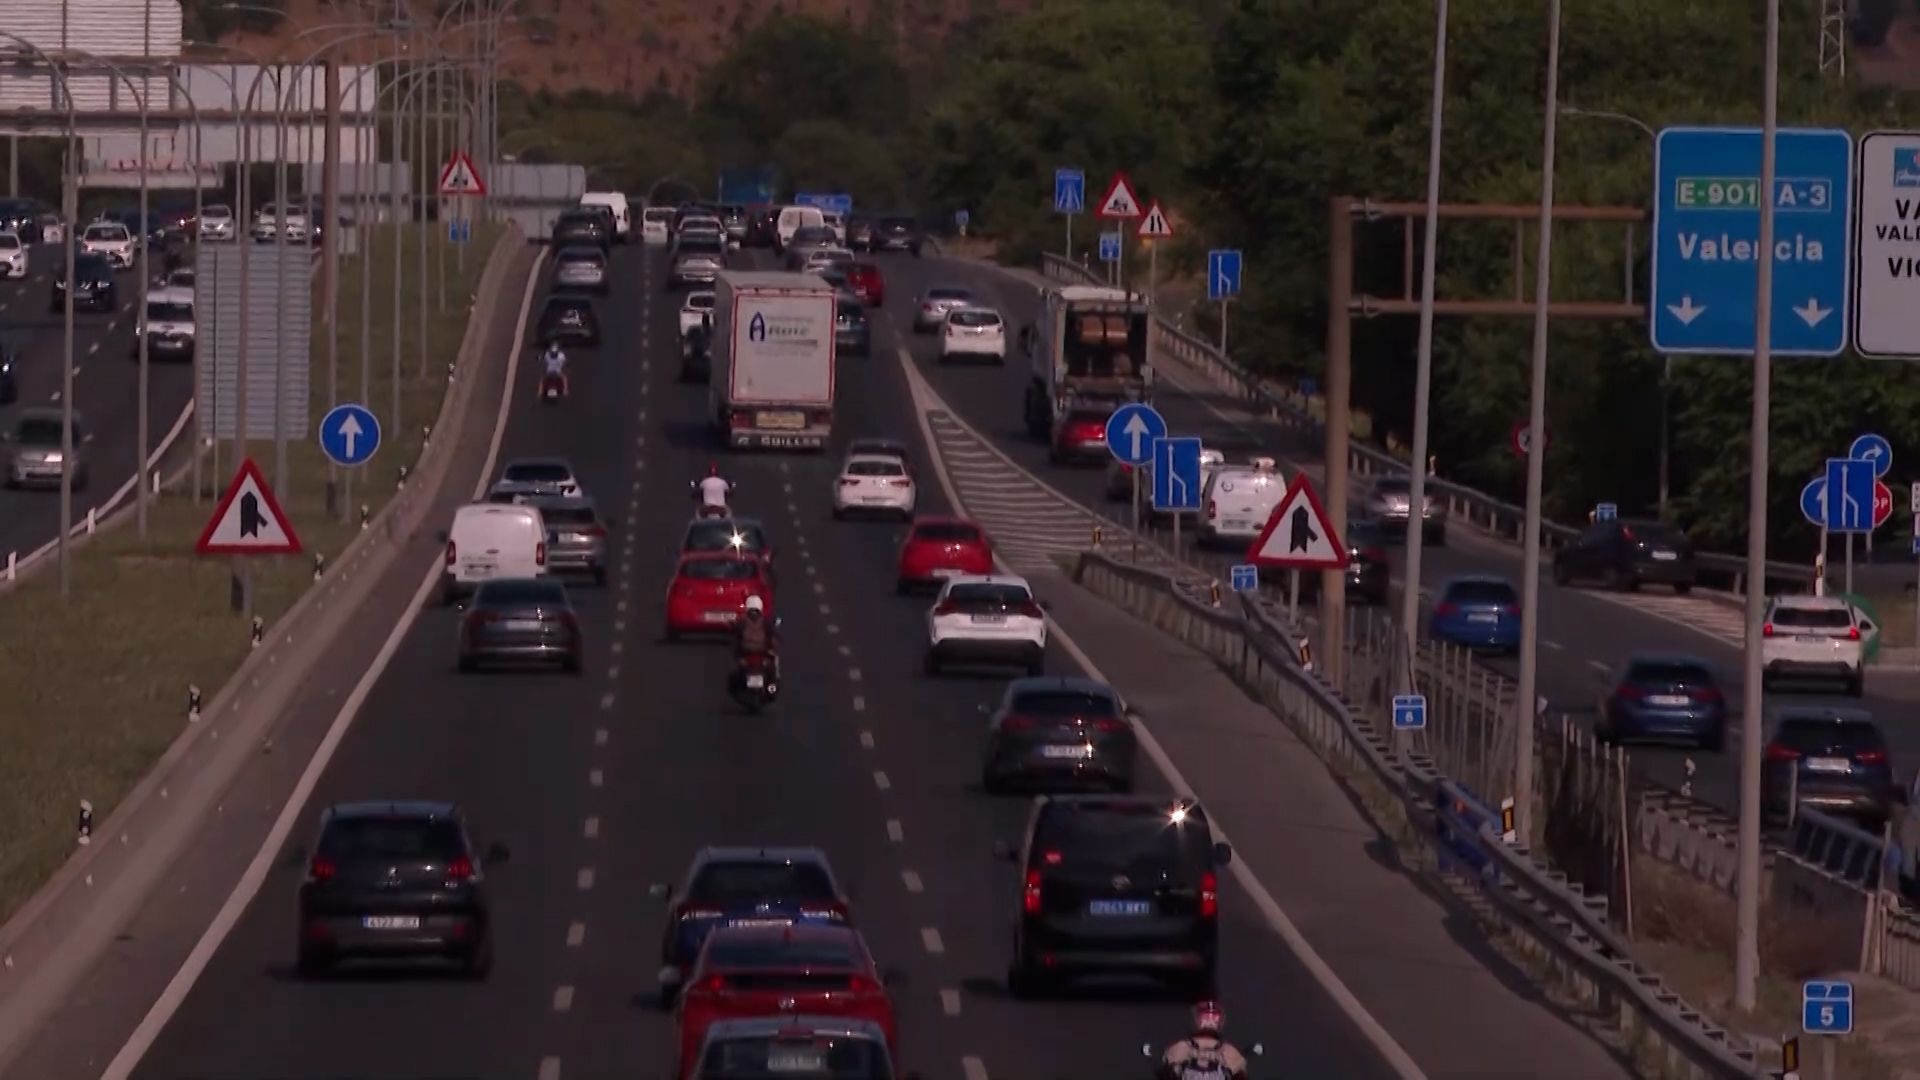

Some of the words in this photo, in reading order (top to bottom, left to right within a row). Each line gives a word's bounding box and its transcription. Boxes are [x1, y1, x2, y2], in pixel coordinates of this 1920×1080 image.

[1679, 182, 1757, 205] E-901
[1777, 183, 1827, 206] A-3
[1820, 1006, 1835, 1027] 5
